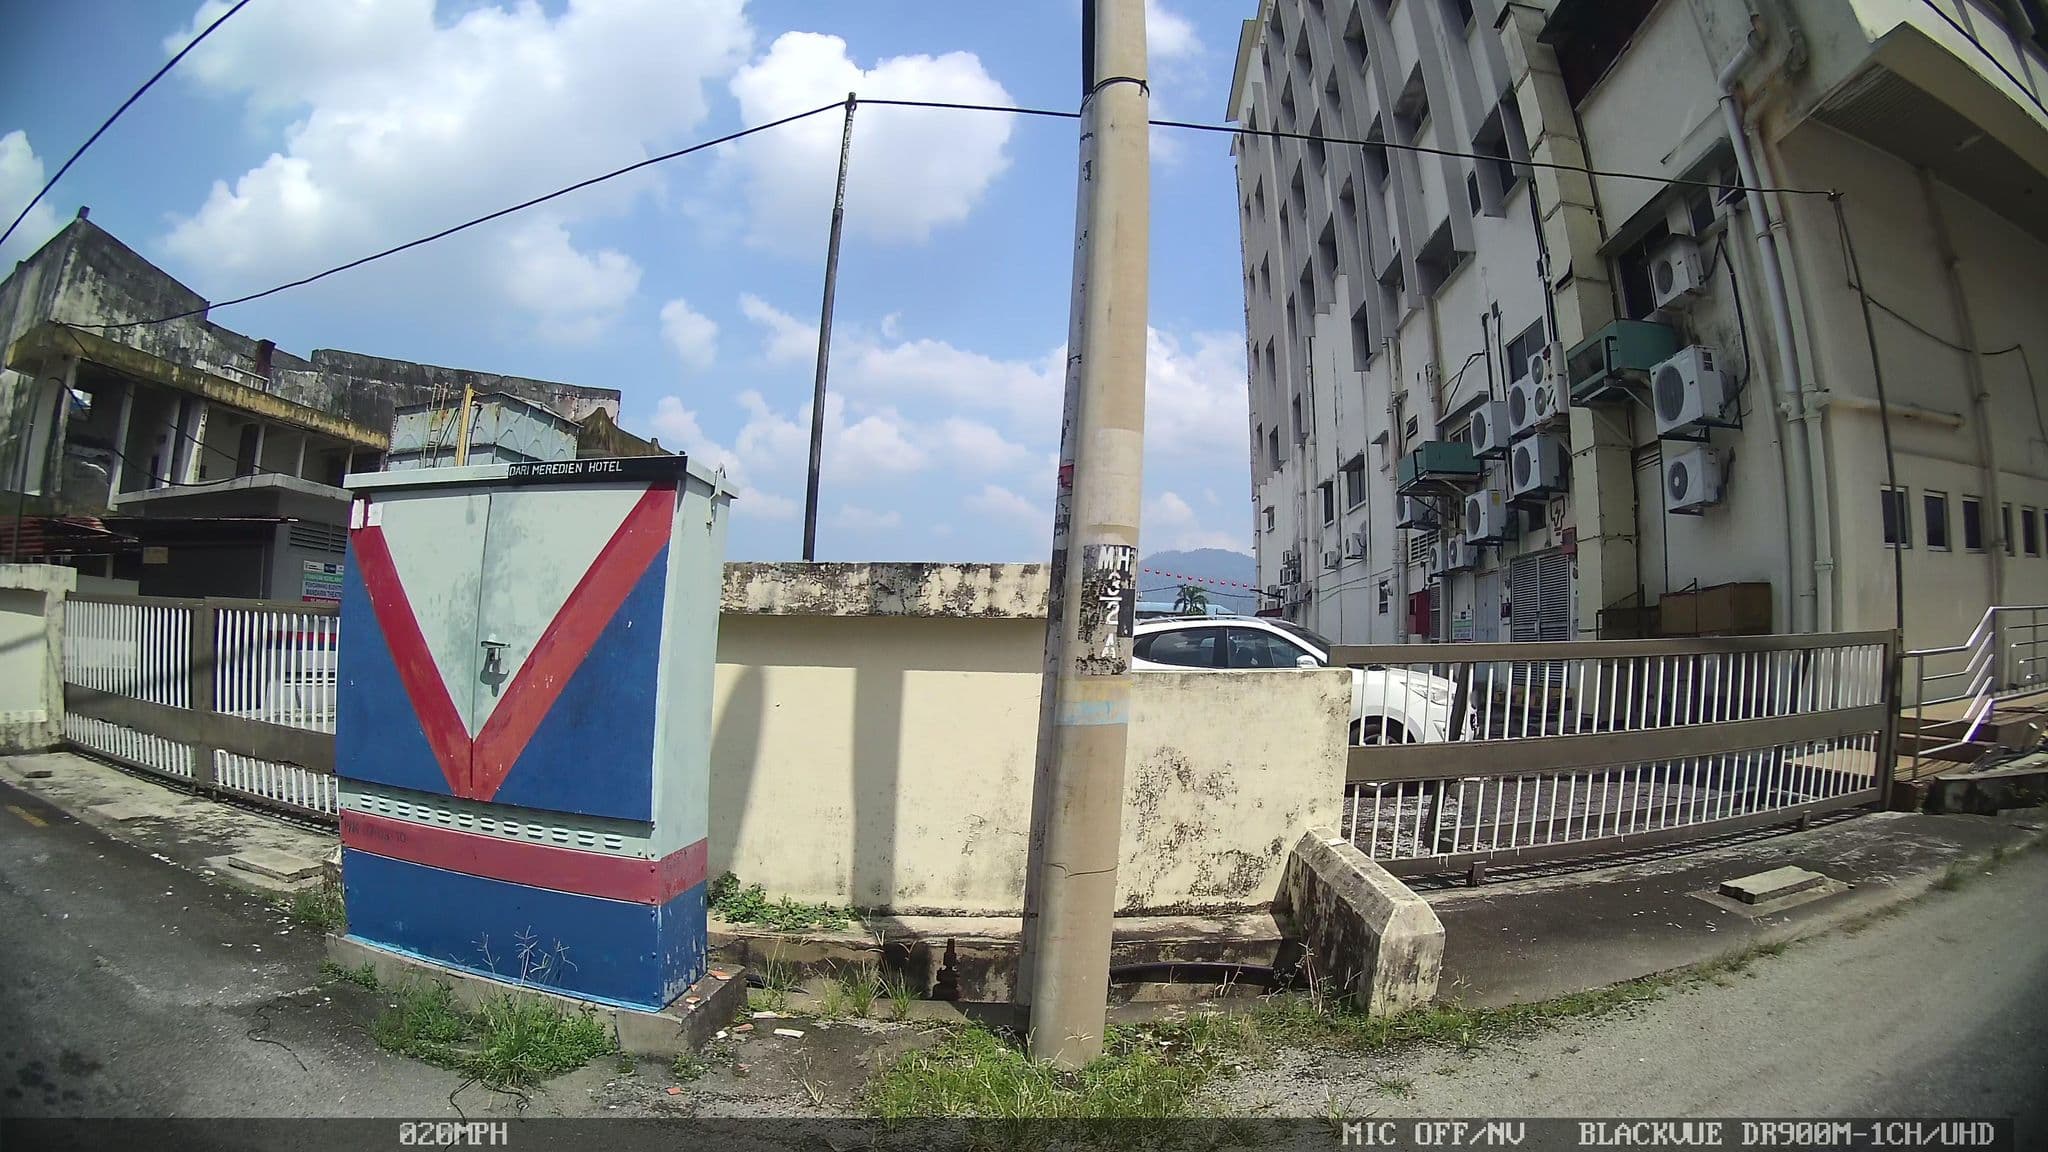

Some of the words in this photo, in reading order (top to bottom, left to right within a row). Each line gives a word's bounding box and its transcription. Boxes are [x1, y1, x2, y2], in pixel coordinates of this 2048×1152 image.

[509, 465, 530, 477] DARI
[531, 462, 583, 476] MEREDIEN
[588, 461, 623, 473] HOTEL
[1098, 546, 1131, 572] MH
[1105, 601, 1120, 625] 2
